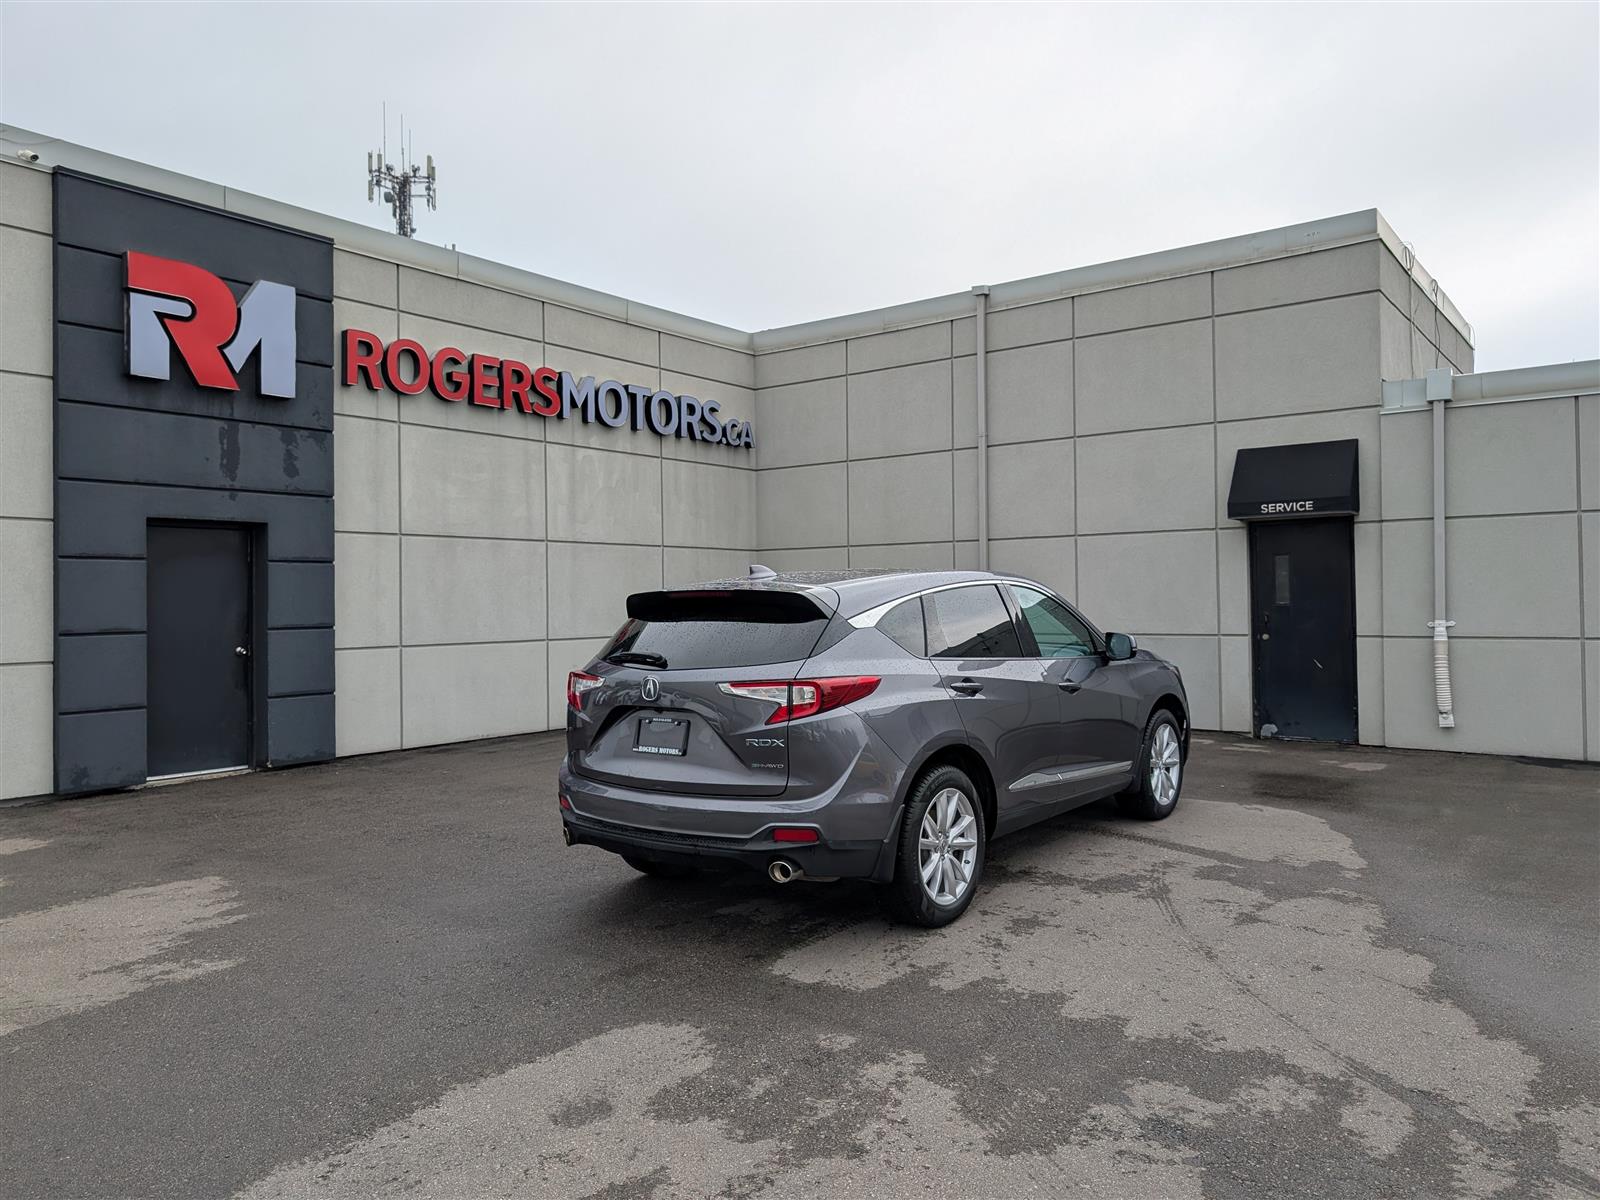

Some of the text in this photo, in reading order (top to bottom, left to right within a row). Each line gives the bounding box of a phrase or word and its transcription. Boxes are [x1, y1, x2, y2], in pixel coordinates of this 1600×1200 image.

[126, 250, 296, 399] RM
[1260, 500, 1314, 514] SERVICE
[745, 738, 785, 747] RDX
